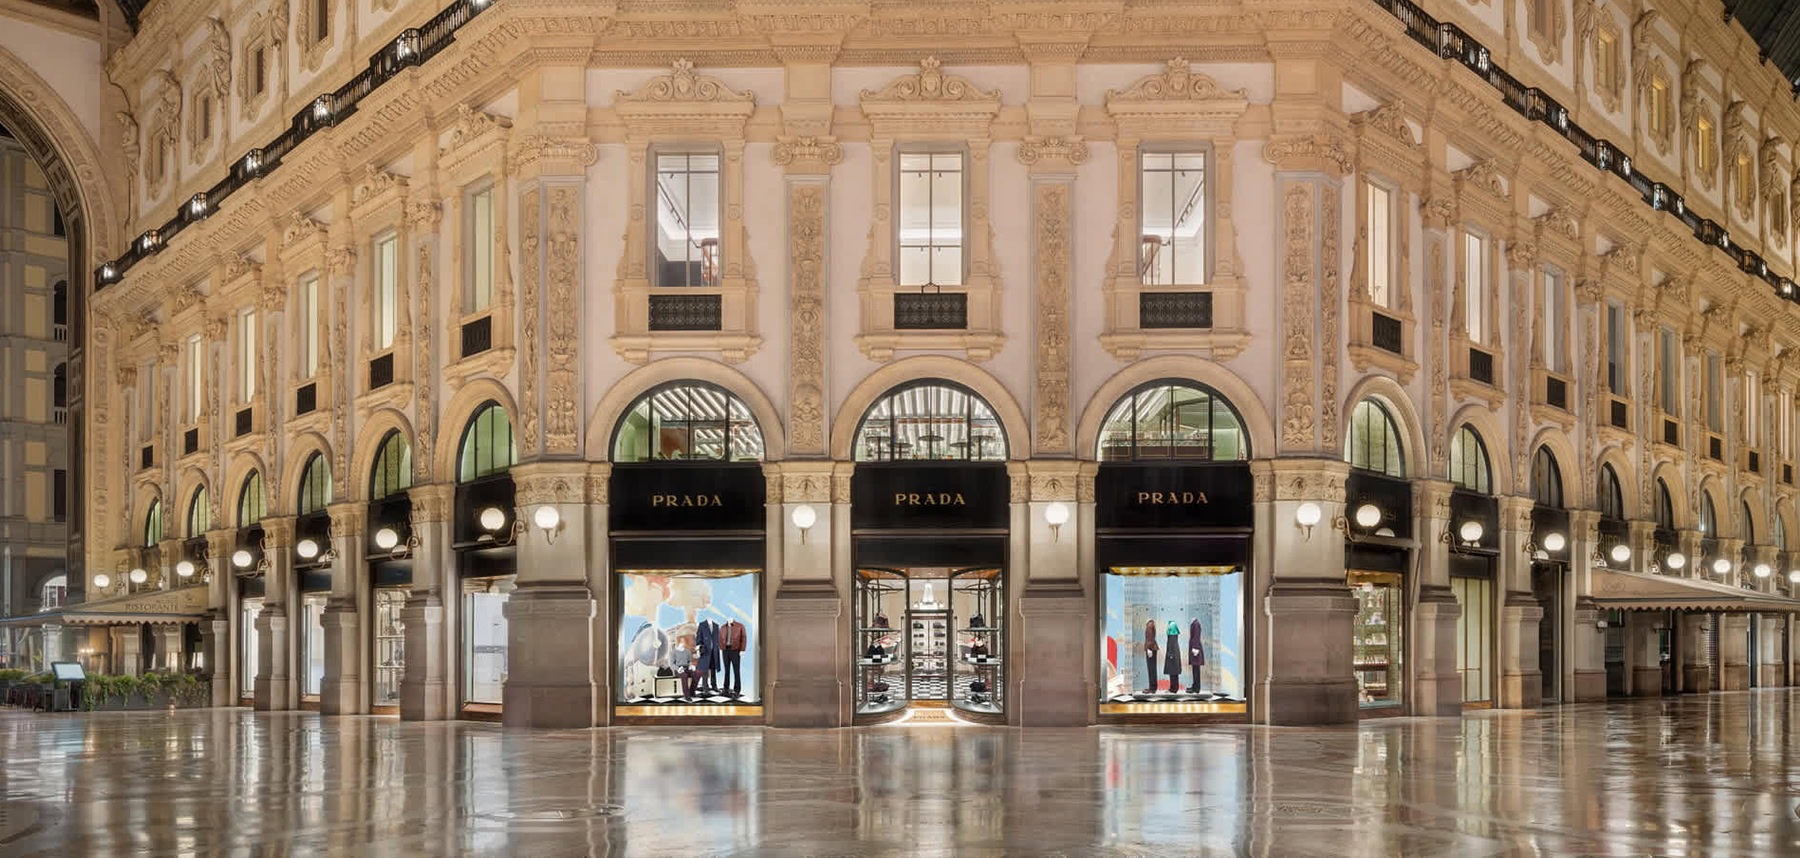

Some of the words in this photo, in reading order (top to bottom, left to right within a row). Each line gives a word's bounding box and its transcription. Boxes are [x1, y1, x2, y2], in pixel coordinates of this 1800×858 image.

[652, 494, 722, 507] PRADA
[894, 493, 966, 506] PRADA
[1138, 491, 1208, 504] PRADA
